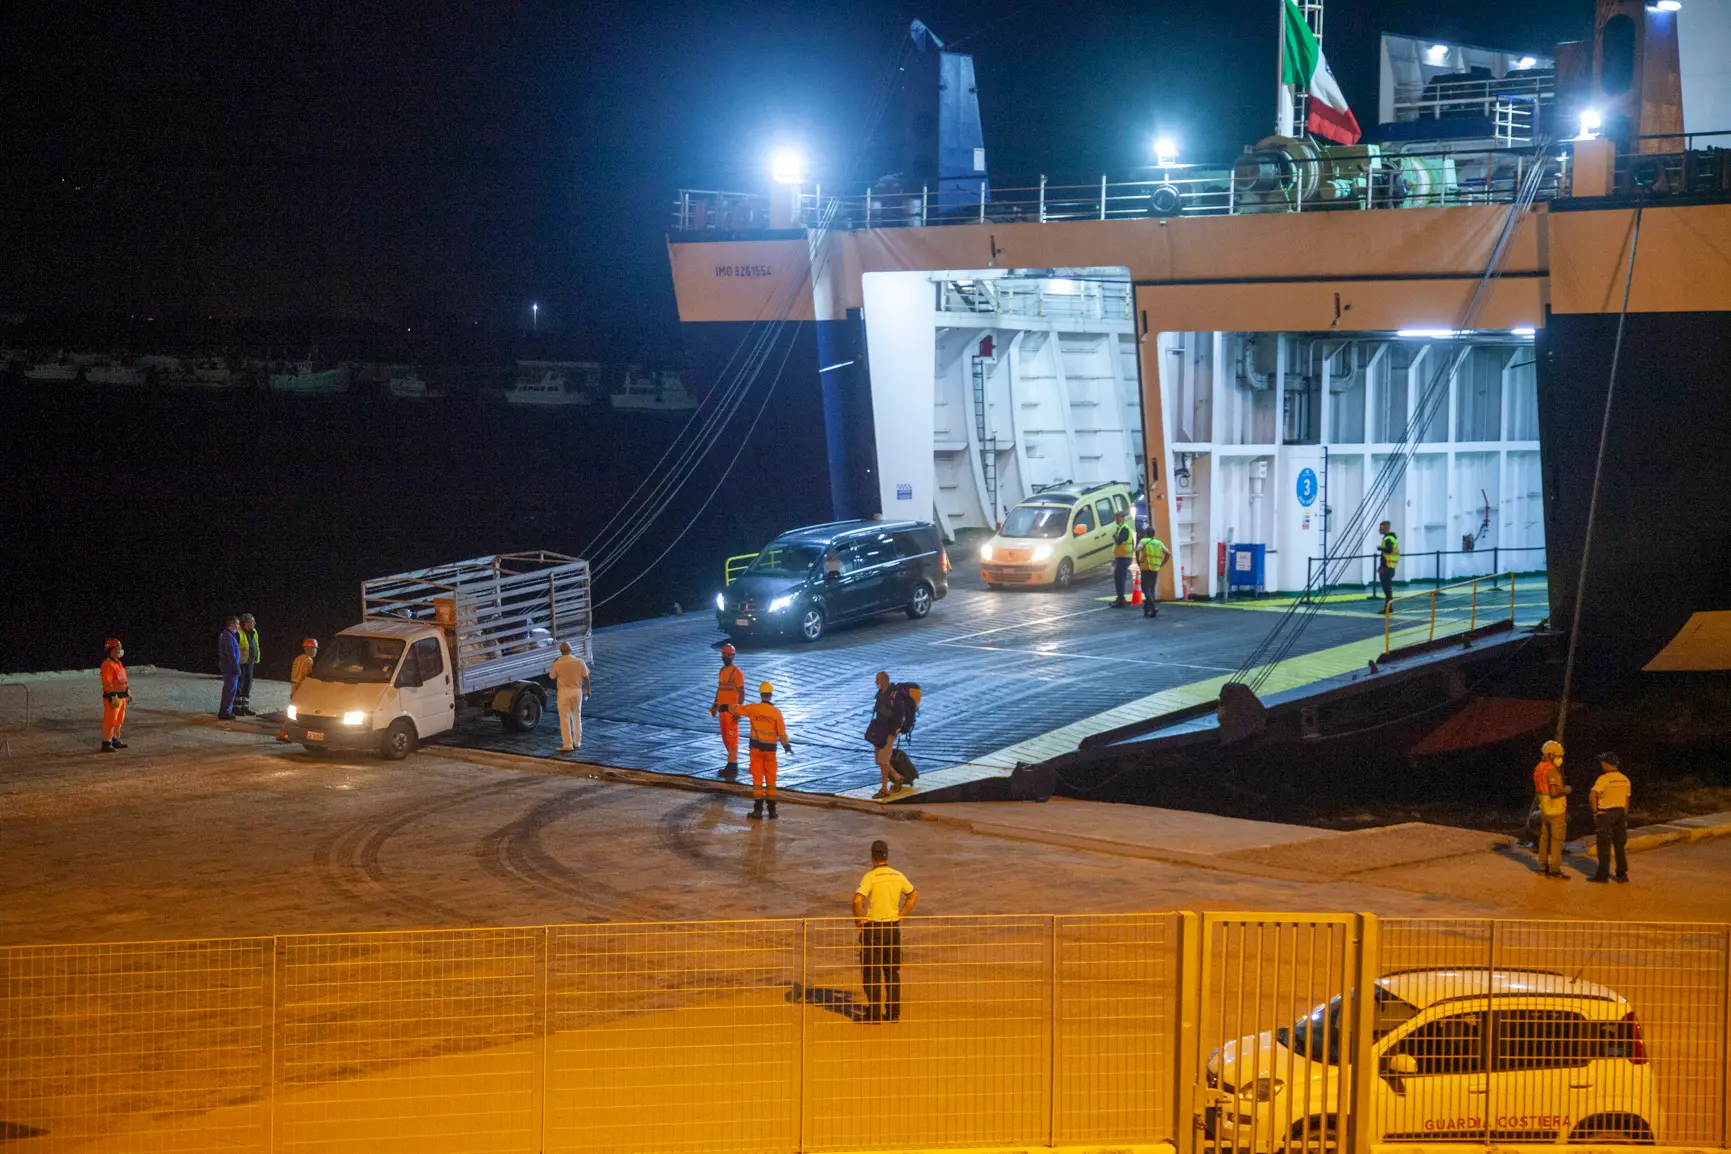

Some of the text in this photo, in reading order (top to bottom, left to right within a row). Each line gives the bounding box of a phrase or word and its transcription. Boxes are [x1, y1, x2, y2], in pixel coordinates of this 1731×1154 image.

[715, 266, 733, 277] IMO
[1303, 478, 1311, 496] 3
[1425, 1115, 1571, 1130] GUARDIA COSTIERA
